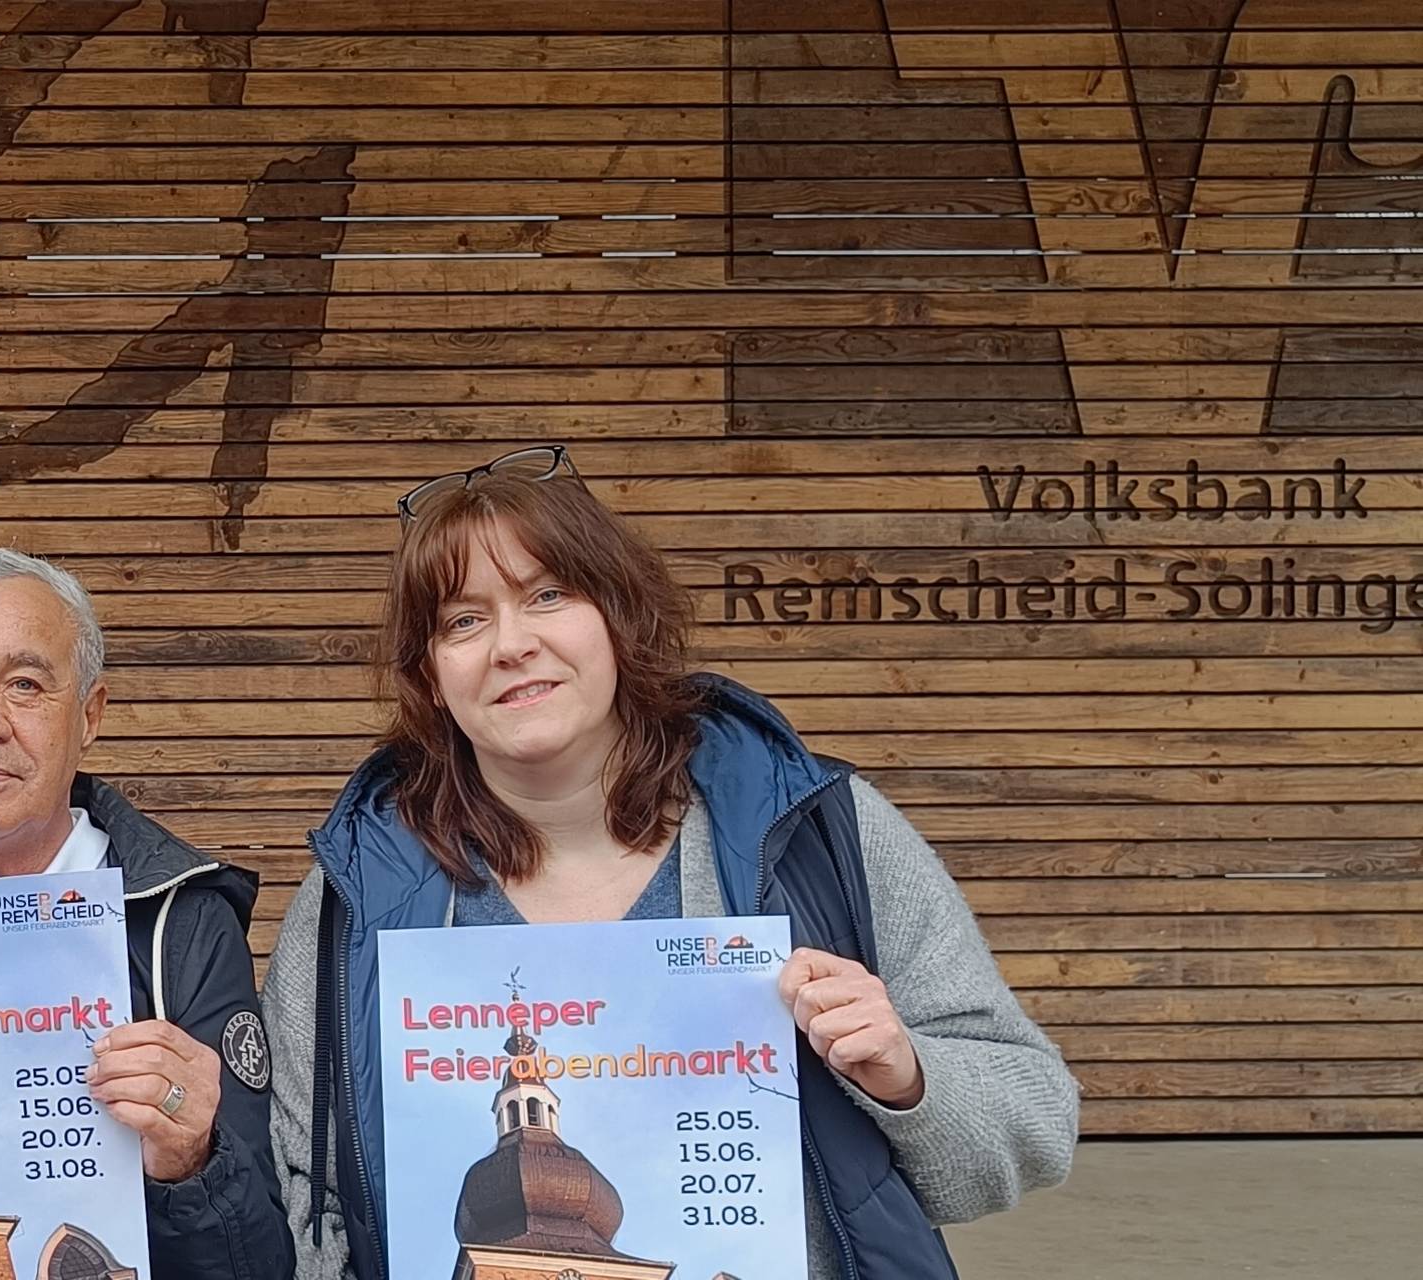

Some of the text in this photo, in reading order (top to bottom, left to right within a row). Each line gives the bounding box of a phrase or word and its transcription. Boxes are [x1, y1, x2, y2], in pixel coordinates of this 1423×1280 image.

[977, 458, 1369, 522] Volksbank
[1, 904, 105, 925] REMSCHEID
[667, 950, 773, 967] REMSCHEID
[402, 997, 606, 1034] Lenneper
[403, 1041, 779, 1082] Feierabendmarkt
[15, 1065, 89, 1088] 25.05
[19, 1096, 100, 1119] 15.06.
[675, 1110, 760, 1132] 25.05.
[21, 1127, 102, 1149] 20.07.
[678, 1142, 762, 1163] 15.06.
[24, 1158, 104, 1180] 31.08.
[680, 1173, 764, 1195] 20.07.
[682, 1205, 766, 1227] 31.08.
